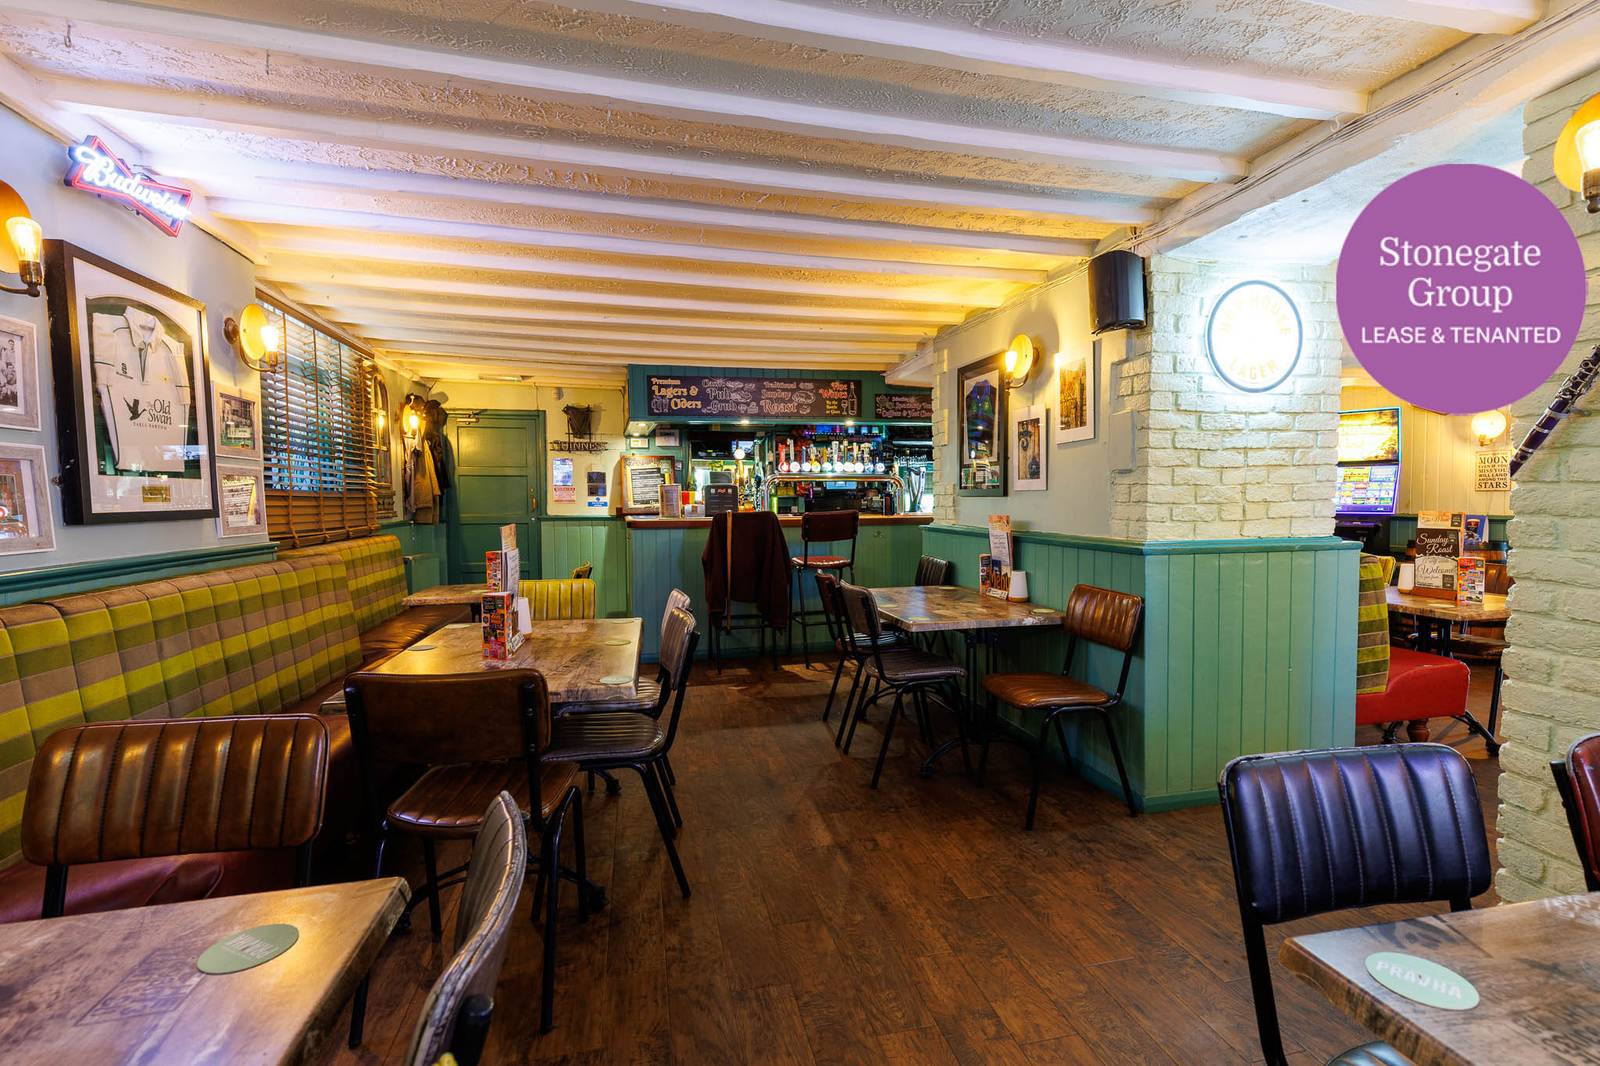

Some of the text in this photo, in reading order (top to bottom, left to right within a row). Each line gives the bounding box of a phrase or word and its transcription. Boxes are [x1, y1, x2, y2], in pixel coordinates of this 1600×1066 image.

[652, 385, 698, 398] Lagers &
[706, 387, 733, 400] Pub
[761, 389, 792, 400] Sunday
[154, 399, 171, 415] Old
[671, 398, 702, 409] Ciders
[709, 400, 738, 413] Grub
[760, 399, 798, 414] Roast
[148, 408, 172, 425] Swan
[551, 441, 606, 451] GUINNESS
[1479, 456, 1508, 464] MOON
[1416, 532, 1449, 546] Sunday
[1425, 543, 1454, 554] Roast
[1416, 564, 1455, 575] Welcome
[1375, 960, 1463, 1000] PRAVHA
